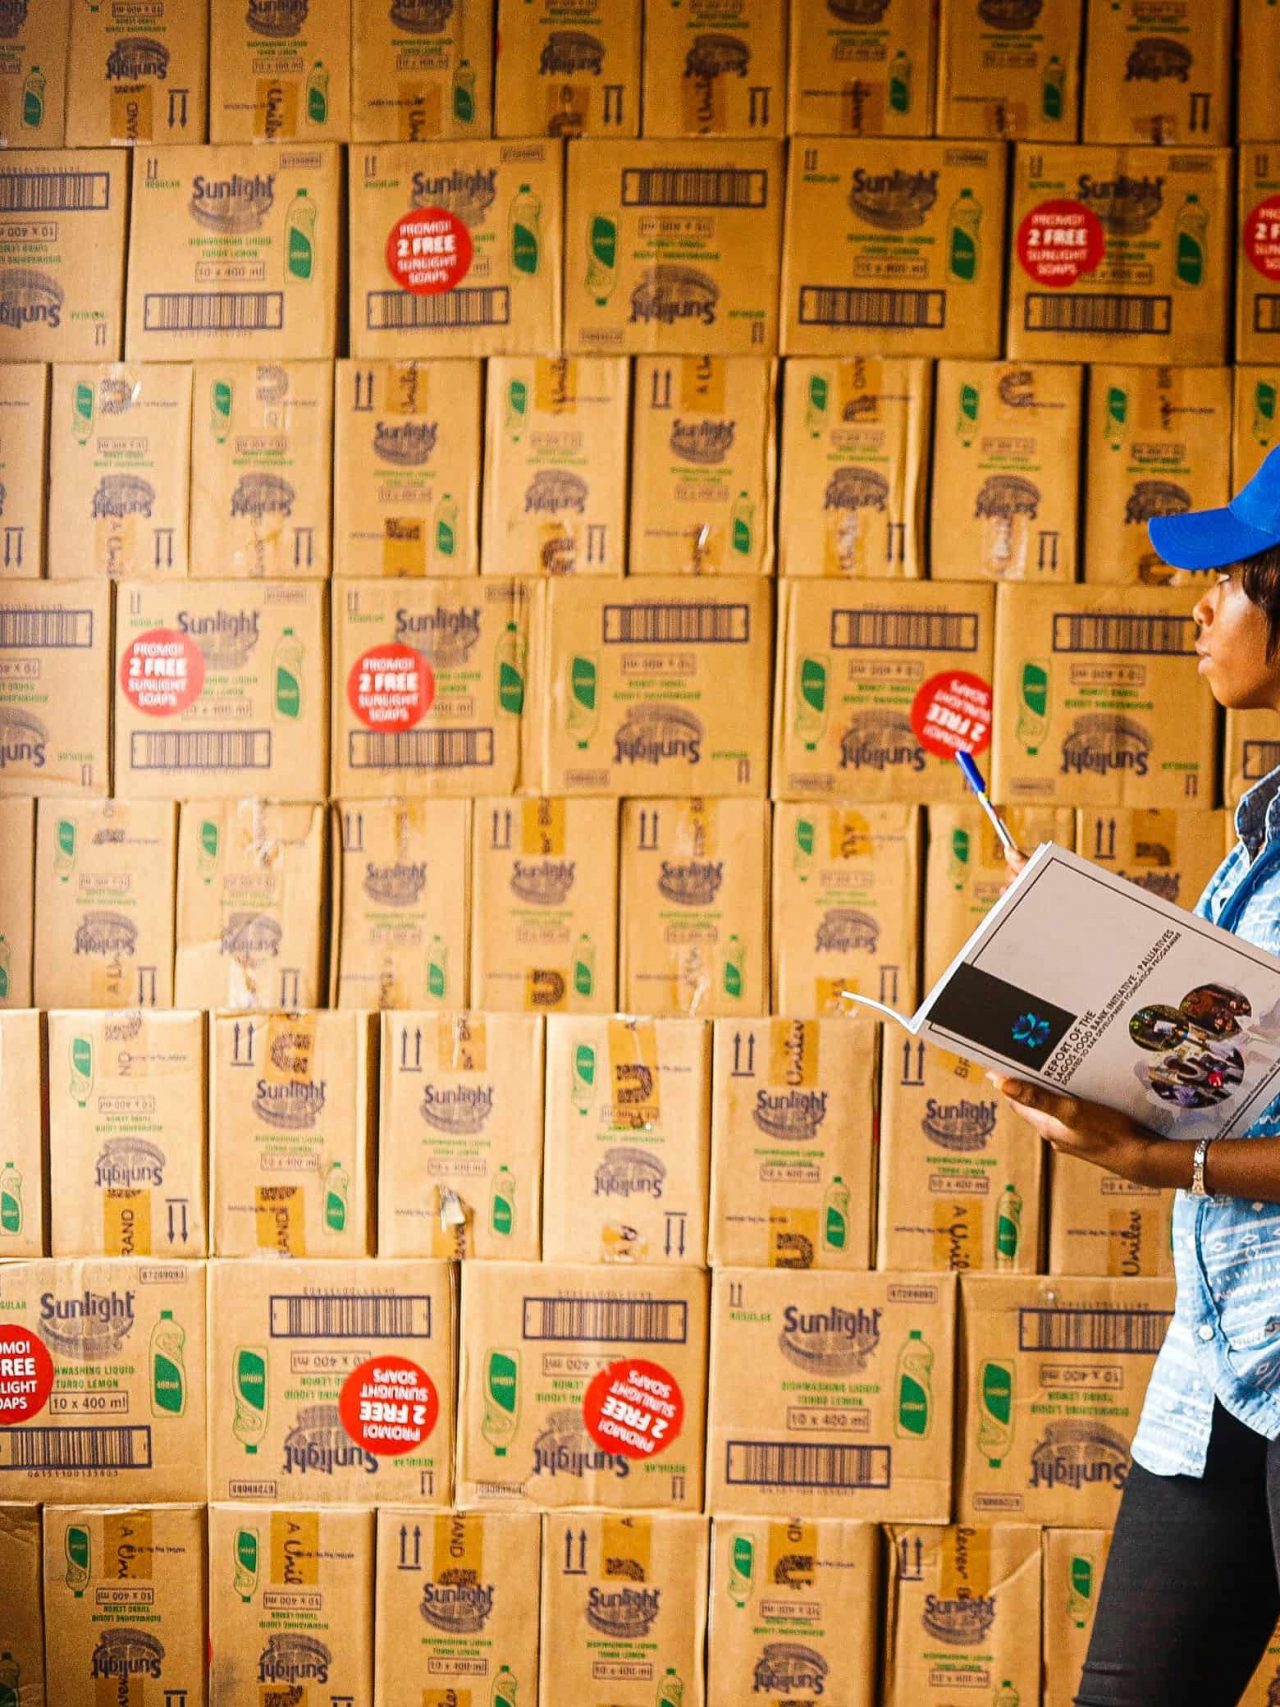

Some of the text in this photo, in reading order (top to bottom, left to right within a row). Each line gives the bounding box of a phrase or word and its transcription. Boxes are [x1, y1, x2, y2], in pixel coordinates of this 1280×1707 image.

[192, 173, 275, 201] Sunlight
[412, 169, 497, 199] Sunlight
[851, 168, 939, 198] Sunlight
[1028, 229, 1087, 246] 2 FREE
[1255, 224, 1267, 240] 2
[398, 235, 455, 257] 2 FREE
[178, 610, 260, 638] Sunlight
[396, 607, 482, 635] Sunlight
[134, 642, 184, 655] PROMO!
[130, 658, 187, 676] 2 FREE
[363, 658, 415, 670] PROMO!
[128, 679, 186, 692] SUNLIGHT
[359, 673, 418, 692] 2 FREE
[359, 693, 418, 707] SUNLIGHT
[926, 703, 986, 741] 2 FREE
[1061, 747, 1149, 775] Sunlight
[1054, 928, 1174, 1082] LAGOS FOOD BANK INITIATIVE PALLIATIVES
[1044, 1010, 1096, 1078] REPORT OF THE
[257, 1079, 326, 1104] Sunlight
[424, 1085, 494, 1107] Sunlight
[758, 1090, 828, 1114] Sunlight
[926, 1098, 997, 1124] Sunlight
[96, 1166, 162, 1188] Sunlight
[40, 1291, 134, 1322] Sunlight
[784, 1306, 882, 1340] Sunlight
[104, 1366, 134, 1376] LIQUID
[373, 1368, 418, 1385] SOAPS
[88, 1380, 118, 1388] LEMON
[360, 1383, 428, 1402] SUNLIGHT
[628, 1370, 672, 1399] SOAPS
[54, 1398, 67, 1409] 10
[82, 1398, 106, 1408] 400
[110, 1396, 126, 1408] ml
[610, 1380, 676, 1419] SUNLIGHT
[360, 1401, 426, 1425] 2 FREE
[600, 1396, 668, 1438] 2 FREE
[792, 1414, 806, 1424] 10
[824, 1415, 846, 1426] 400
[850, 1416, 869, 1426] ml
[362, 1424, 420, 1442] PROMO!
[597, 1419, 656, 1453] PROMO!
[283, 1442, 379, 1475] Sunlight
[531, 1446, 630, 1478] Sunlight
[1030, 1457, 1126, 1490] Sunlight
[98, 1592, 110, 1600] ml
[112, 1592, 129, 1600] 400
[141, 1592, 152, 1600] 10
[424, 1584, 494, 1606] Sunlight
[92, 1657, 161, 1679] Sunlight
[258, 1659, 328, 1684] Sunlight
[754, 1672, 825, 1695] Sunlight
